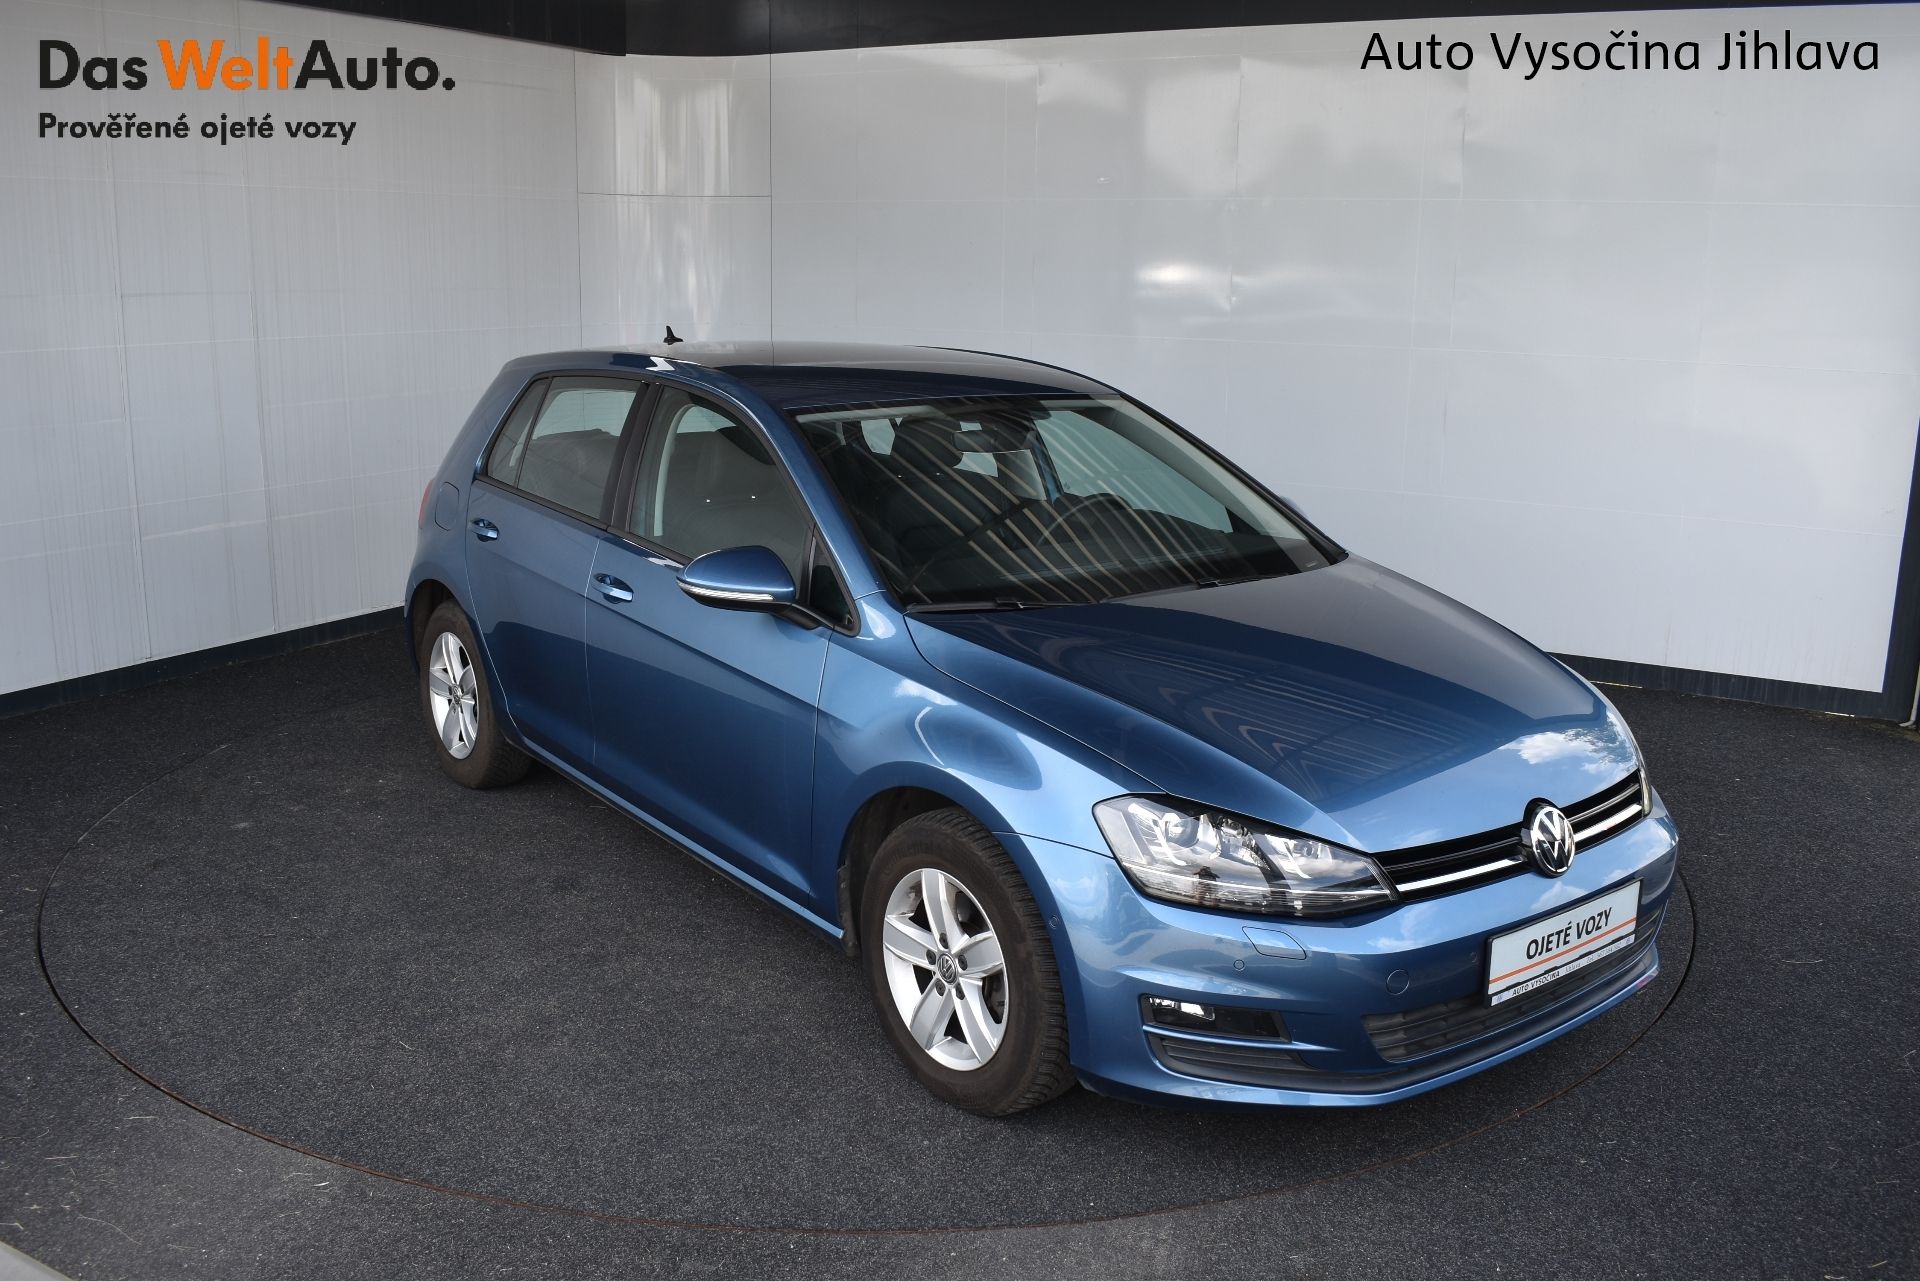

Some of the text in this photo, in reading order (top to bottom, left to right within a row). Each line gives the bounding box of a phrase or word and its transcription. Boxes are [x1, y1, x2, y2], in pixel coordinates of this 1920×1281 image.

[1526, 920, 1573, 960] OJETÉ
[1576, 906, 1613, 940] VOZY
[1512, 984, 1530, 997] AUTO
